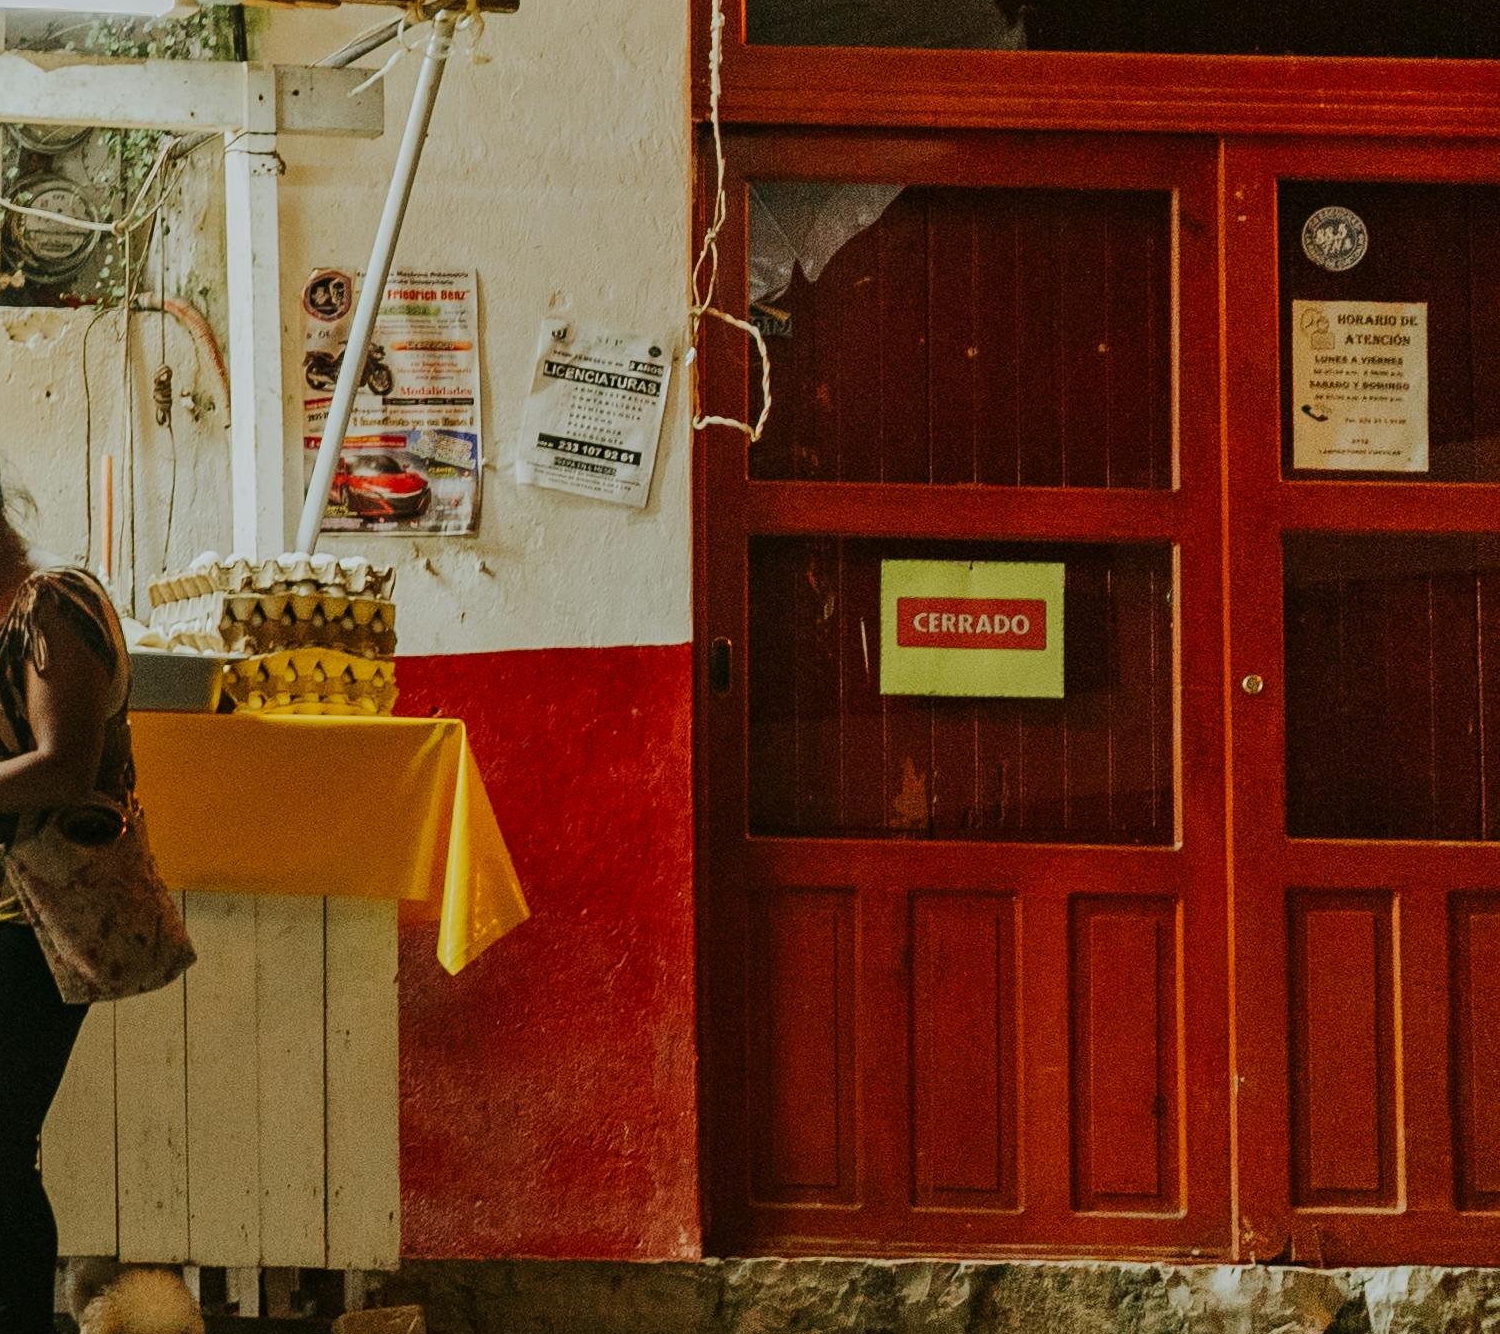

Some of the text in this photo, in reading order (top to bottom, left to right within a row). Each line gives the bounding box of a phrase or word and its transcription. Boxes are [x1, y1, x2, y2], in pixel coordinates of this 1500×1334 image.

[1337, 314, 1418, 326] HORARIO DE
[1315, 355, 1348, 364] LUNES
[557, 440, 579, 453] 233
[582, 444, 602, 456] 107
[912, 612, 1030, 636] CERRADO
